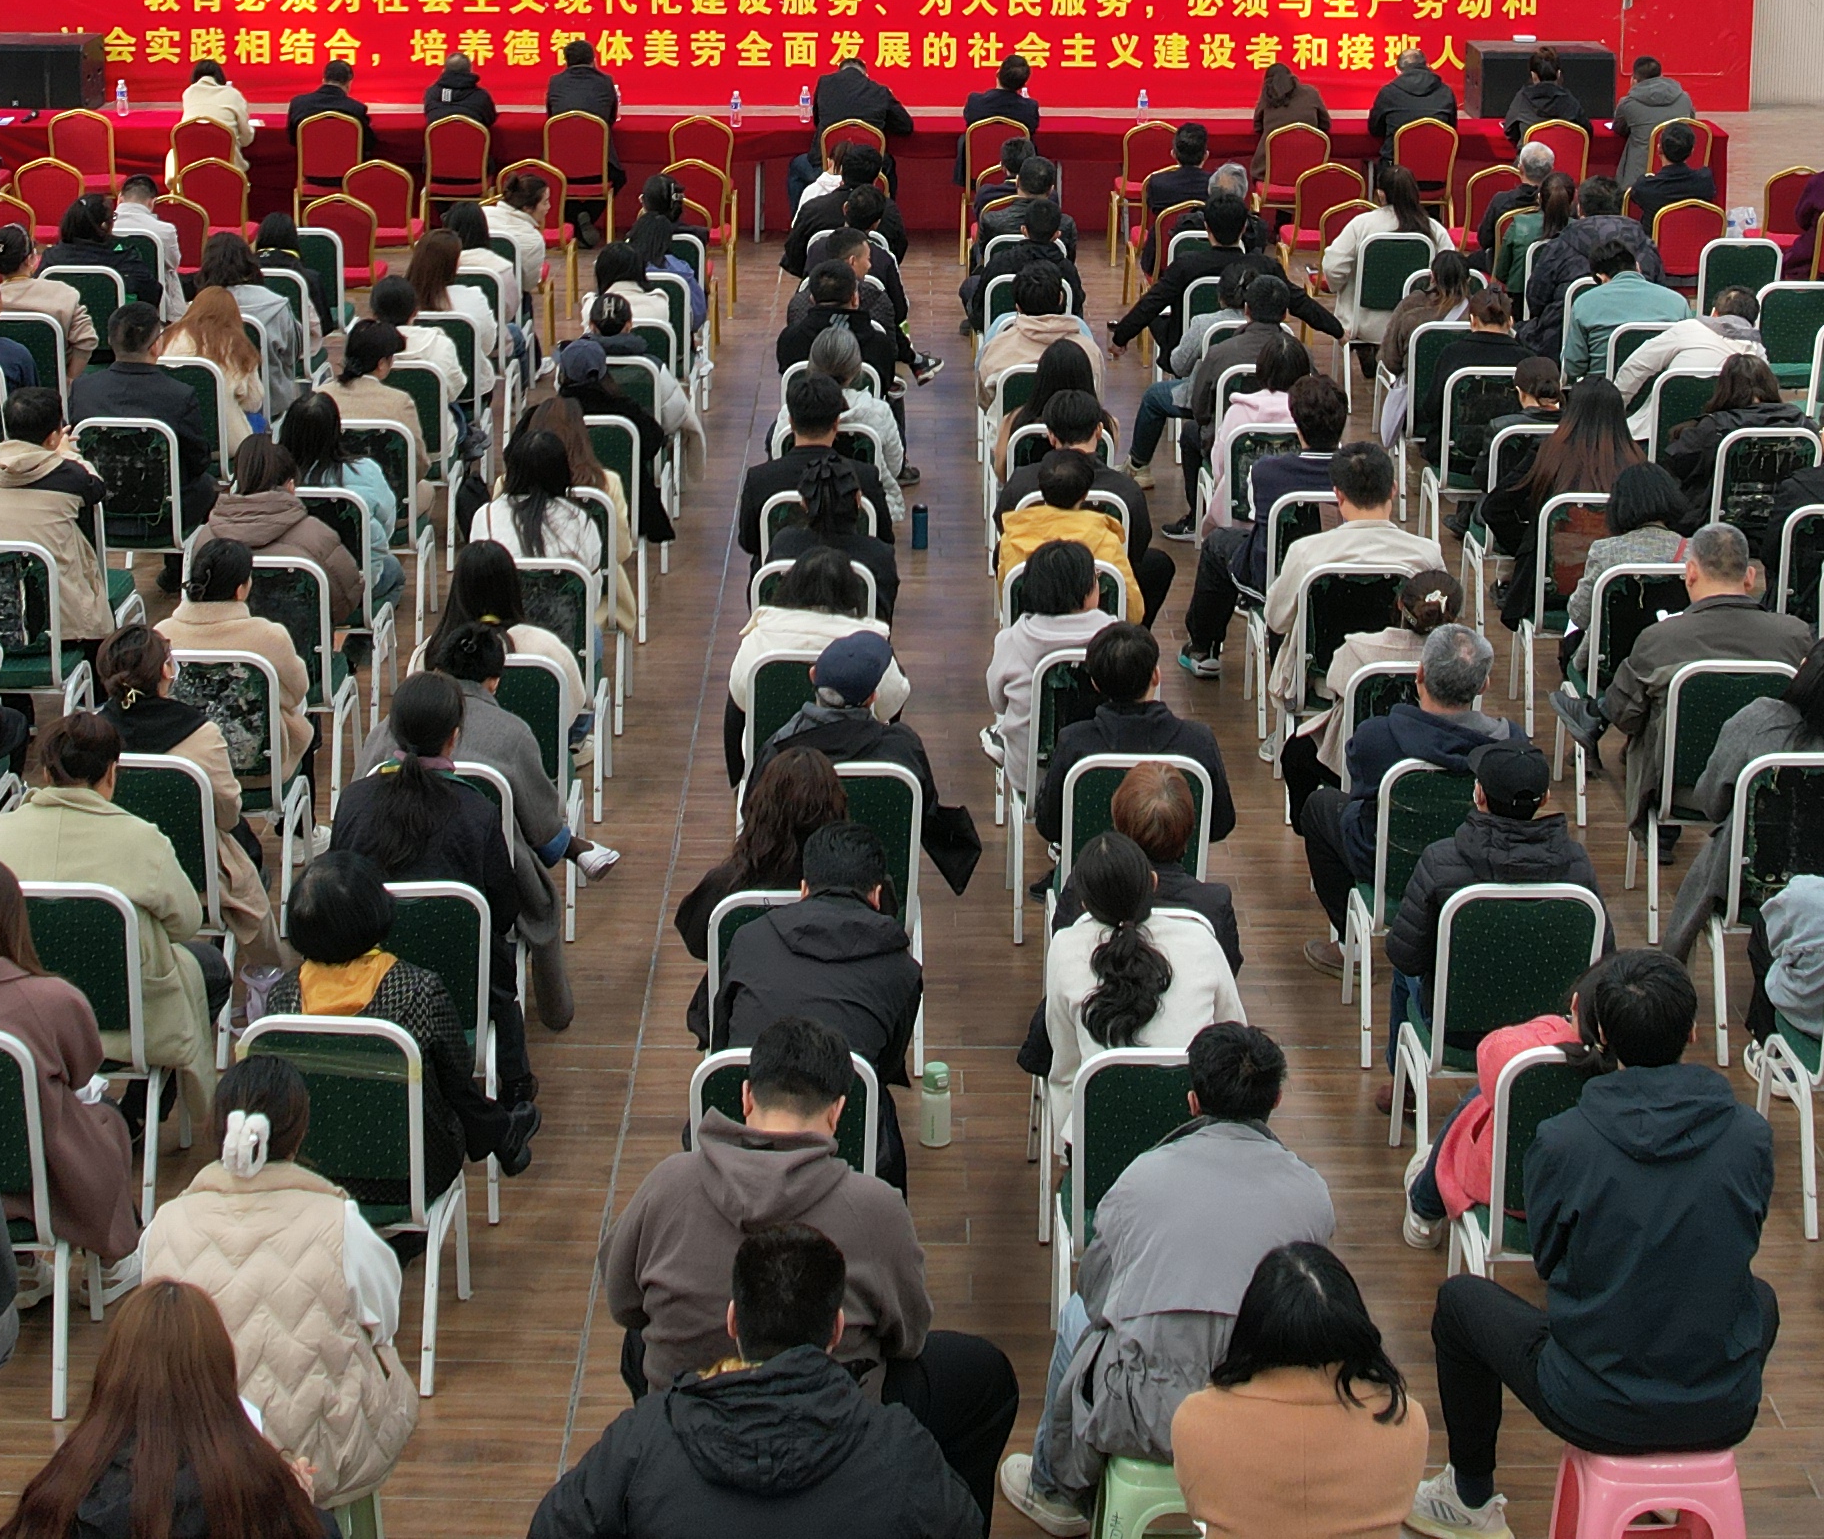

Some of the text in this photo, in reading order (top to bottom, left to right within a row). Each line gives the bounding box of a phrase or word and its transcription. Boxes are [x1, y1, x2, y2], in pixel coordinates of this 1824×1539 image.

[60, 26, 1466, 71] 会实践相结合，培养德智体美劳全面发展的社会主义建设者和接班人
